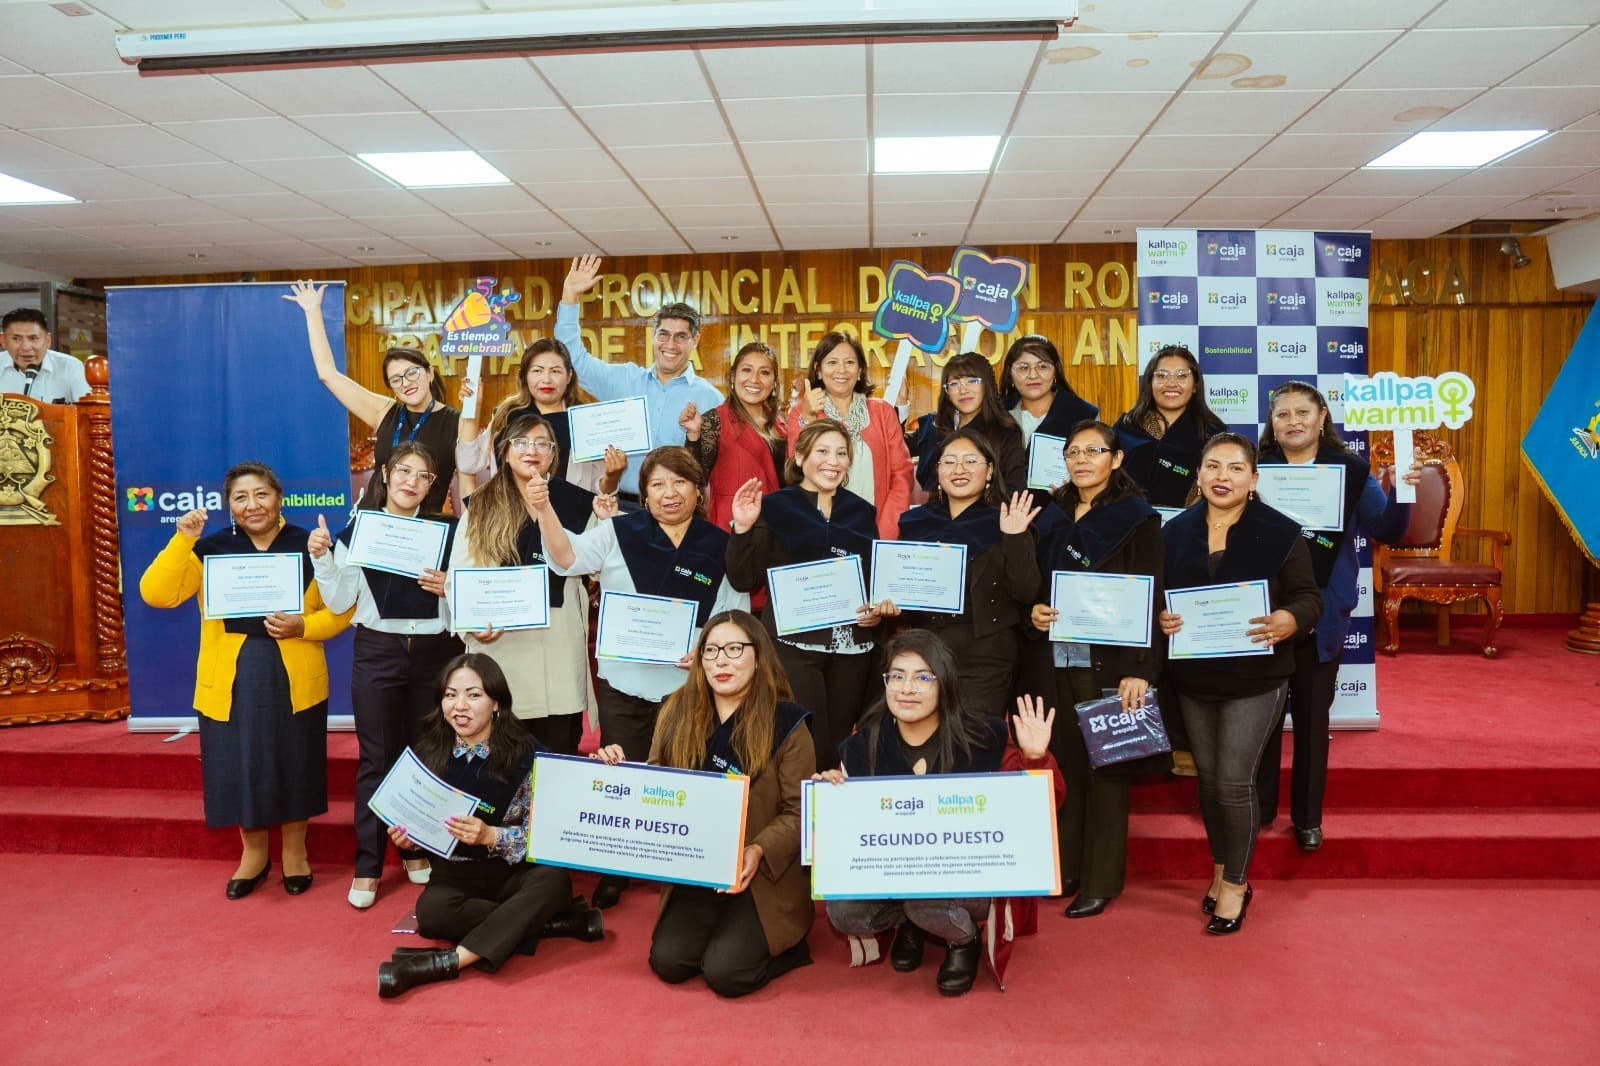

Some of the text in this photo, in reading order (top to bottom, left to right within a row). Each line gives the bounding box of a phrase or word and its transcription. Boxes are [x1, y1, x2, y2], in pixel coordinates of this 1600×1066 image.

[1148, 240, 1177, 249] kallpa
[1220, 244, 1246, 257] caja
[1279, 245, 1304, 257] caja
[1148, 249, 1178, 257] warmi
[1338, 245, 1361, 258] caja
[579, 268, 831, 319] PROVINCIAL
[977, 282, 1008, 298] caja
[1327, 291, 1354, 300] kallpa
[895, 290, 930, 310] kallpa
[1162, 292, 1188, 305] caja
[1221, 293, 1246, 305] caja
[1280, 293, 1305, 306] caja
[1328, 300, 1354, 308] warmi
[892, 302, 928, 320] warmi
[447, 331, 500, 343] Es tiempo
[1072, 318, 1137, 366] AN
[442, 342, 456, 352] de
[1280, 342, 1306, 354] caja
[1340, 341, 1364, 354] caja
[1210, 388, 1238, 397] kallpa
[1344, 378, 1432, 406] kallpa
[1210, 397, 1238, 405] warmi
[1344, 400, 1435, 425] warmi
[159, 486, 222, 511] caja
[282, 494, 344, 506] nibilidad
[1341, 680, 1366, 692] caja
[1108, 708, 1147, 727] caja
[605, 784, 631, 796] caja
[643, 785, 675, 798] kallpa
[642, 796, 674, 806] warmi
[895, 797, 924, 811] caja
[938, 795, 973, 806] kallpa
[938, 805, 974, 815] warmi
[580, 811, 689, 836] PRIMER PUESTO
[860, 830, 1004, 847] SEGUNDO PUESTO
